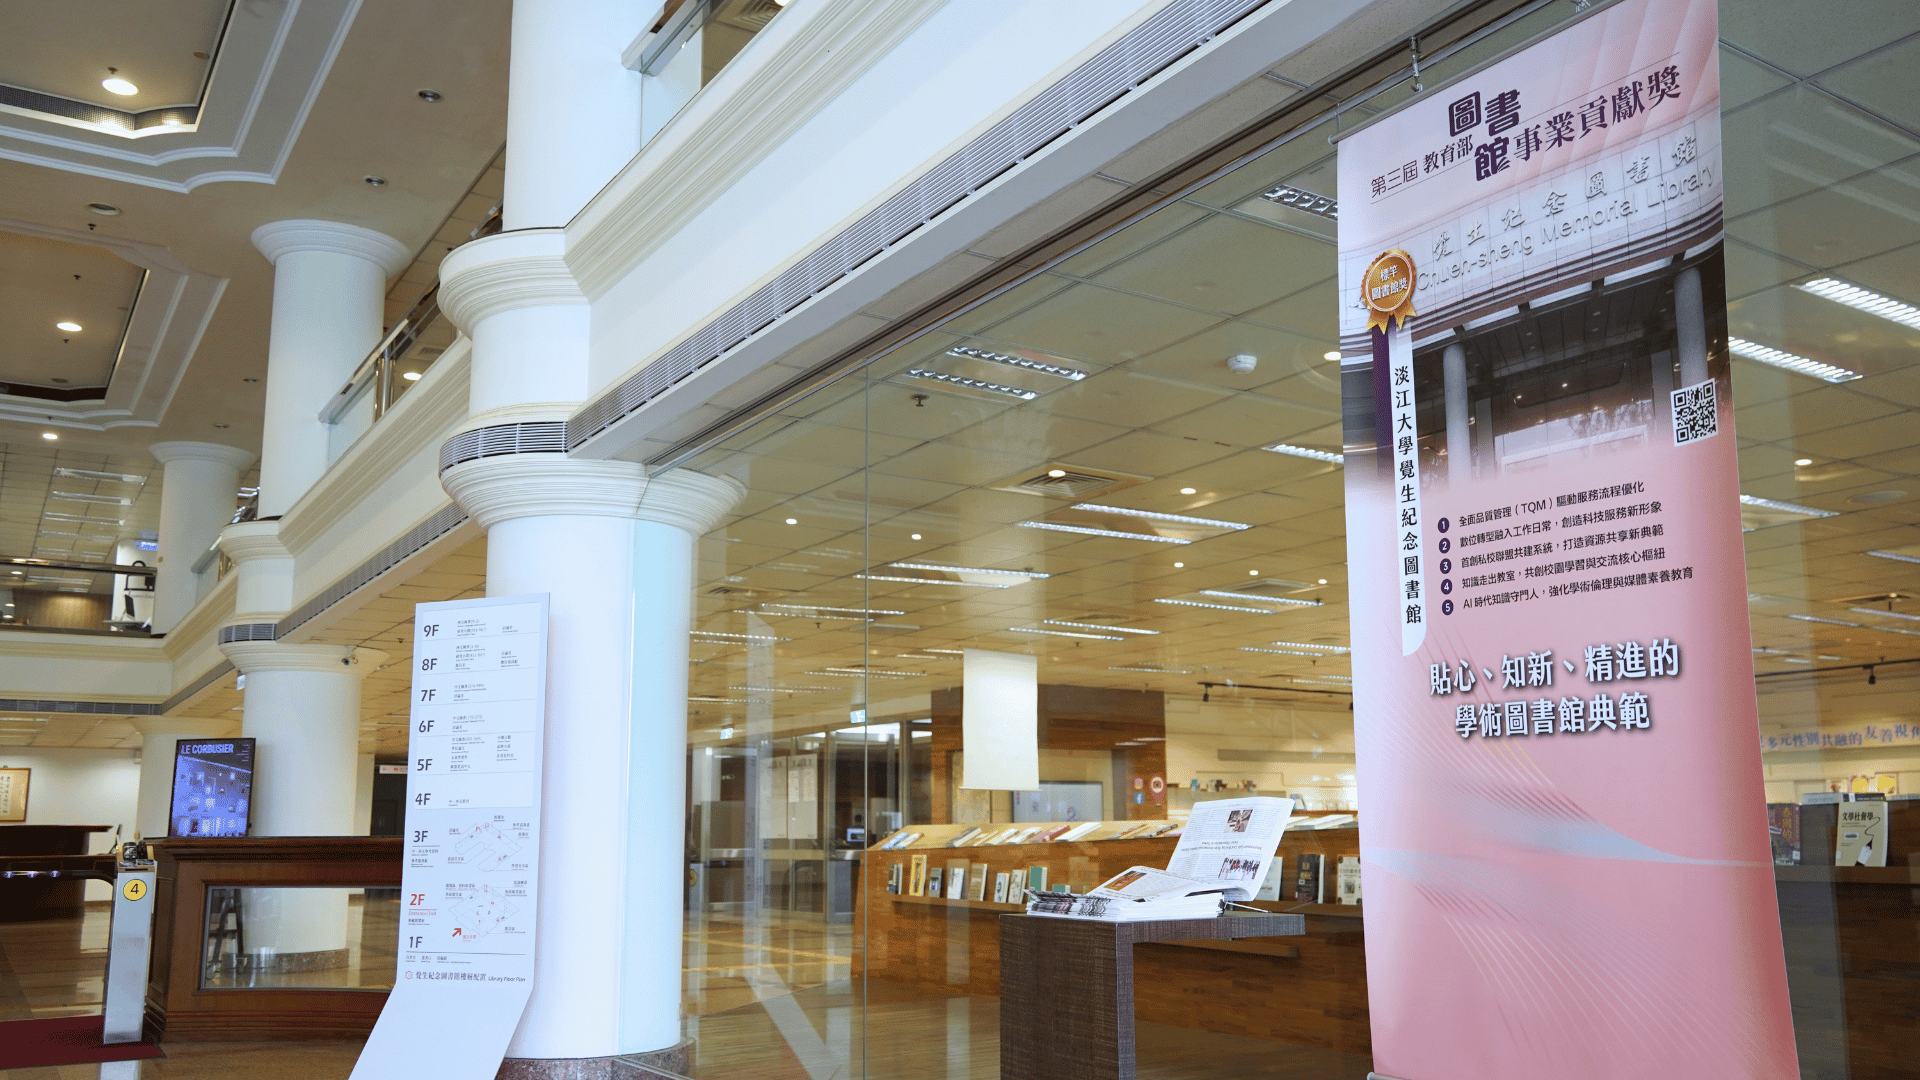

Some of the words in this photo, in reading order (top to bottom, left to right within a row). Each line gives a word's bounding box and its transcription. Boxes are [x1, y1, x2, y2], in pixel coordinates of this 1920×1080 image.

[1370, 160, 1418, 198] 第三屆
[1422, 133, 1474, 174] 教育部
[1513, 65, 1681, 162] 事業貢獻獎
[1417, 233, 1534, 292] Chuen-sheng
[1541, 192, 1639, 246] Memorial
[1646, 160, 1717, 209] Library
[1371, 277, 1408, 301] 圖書館獎
[1394, 364, 1422, 625] 淡江大學覺生紀念圖書館
[423, 624, 439, 637] 9F
[421, 658, 438, 671] 8F
[1430, 637, 1680, 696] 貼心、知新、精進的
[420, 689, 436, 702] 7F
[1454, 691, 1651, 739] 學術圖書館典範
[418, 719, 435, 733] 6F
[1760, 723, 1920, 748] 多元性別共融的友善視角
[181, 744, 191, 754] LE
[192, 743, 234, 754] CORBUSIER
[417, 758, 433, 772] 5F
[415, 792, 431, 806] 4F
[413, 830, 428, 843] 3F
[409, 893, 425, 906] 2F
[409, 936, 423, 949] 1F
